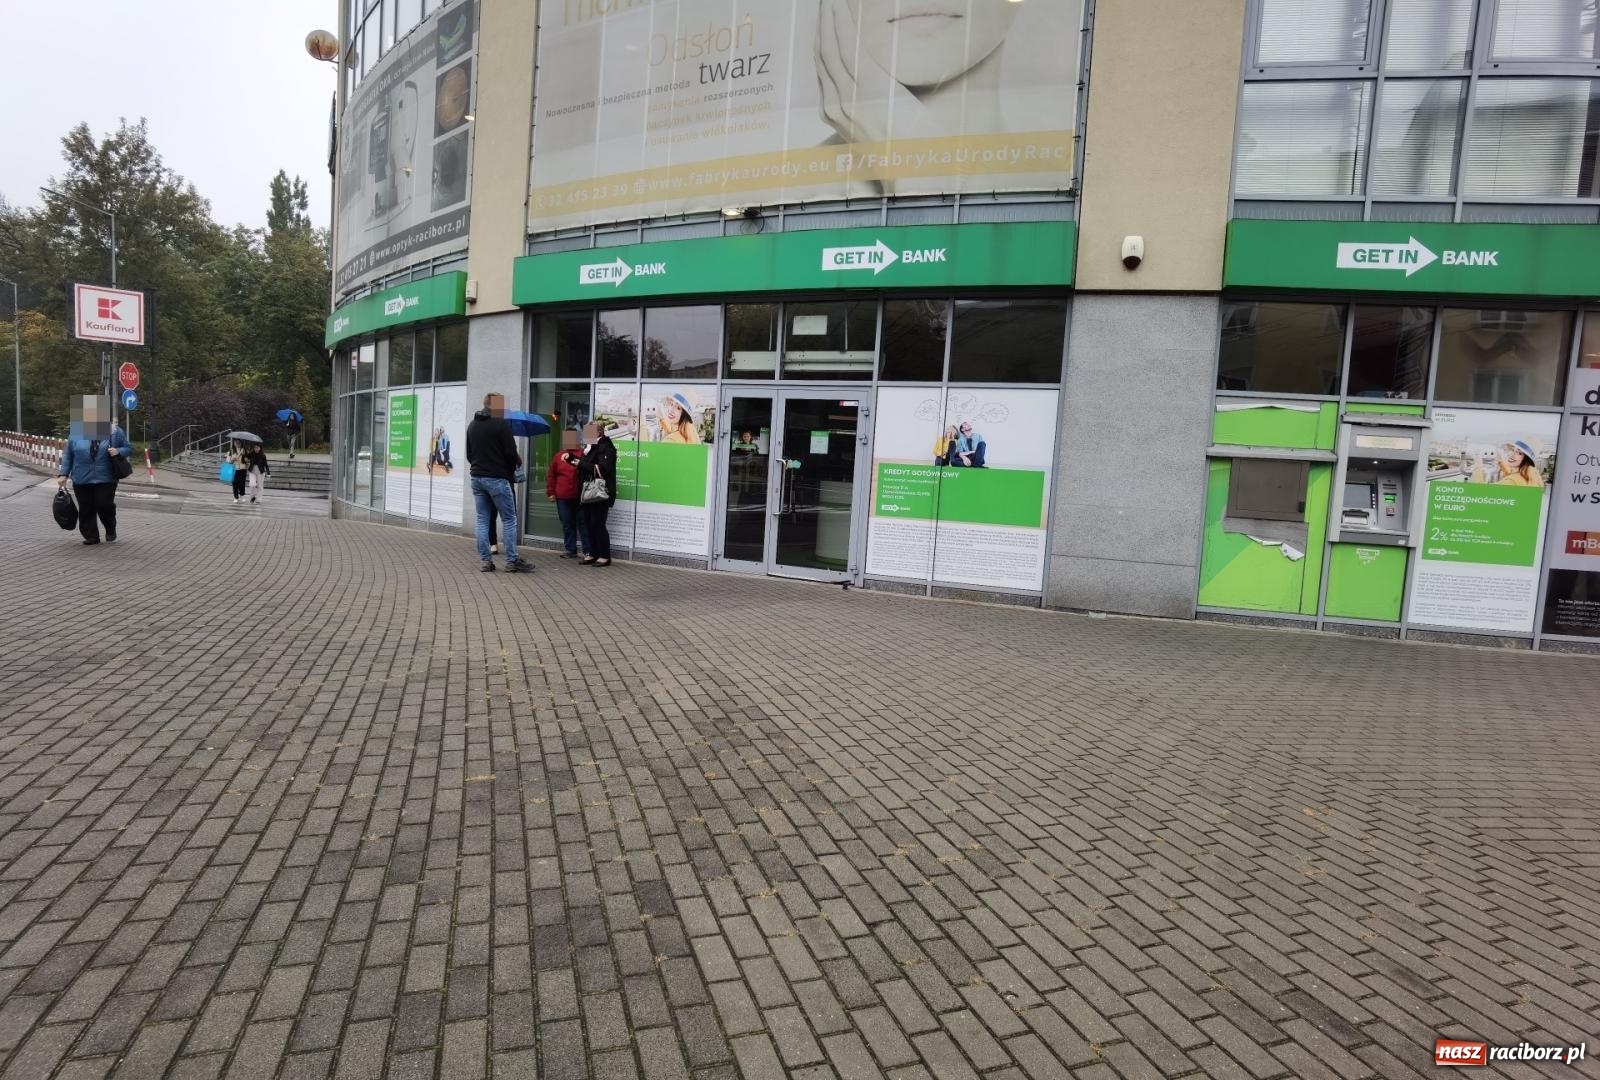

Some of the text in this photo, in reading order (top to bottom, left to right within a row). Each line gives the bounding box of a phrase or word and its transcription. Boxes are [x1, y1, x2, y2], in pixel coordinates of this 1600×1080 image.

[647, 12, 755, 66] Odsłoń
[698, 52, 772, 85] twarz
[602, 88, 653, 106] bezpieczna
[654, 79, 691, 94] metoda
[703, 82, 774, 103] rozszerzonych
[376, 214, 466, 260] www.optyk-raciborz.pl
[834, 248, 947, 265] GET IN BANK
[1352, 248, 1499, 266] GET IN BANK
[587, 267, 610, 280] GET
[634, 262, 667, 276] BANK
[86, 321, 135, 334] Kaufland
[121, 371, 137, 381] STOP
[884, 468, 911, 476] KREDYT
[1573, 471, 1591, 485] ile
[1435, 486, 1465, 494] KONTO
[1434, 494, 1516, 506] OSZCZĘDNOŚCIOWE
[1443, 504, 1466, 512] EURO
